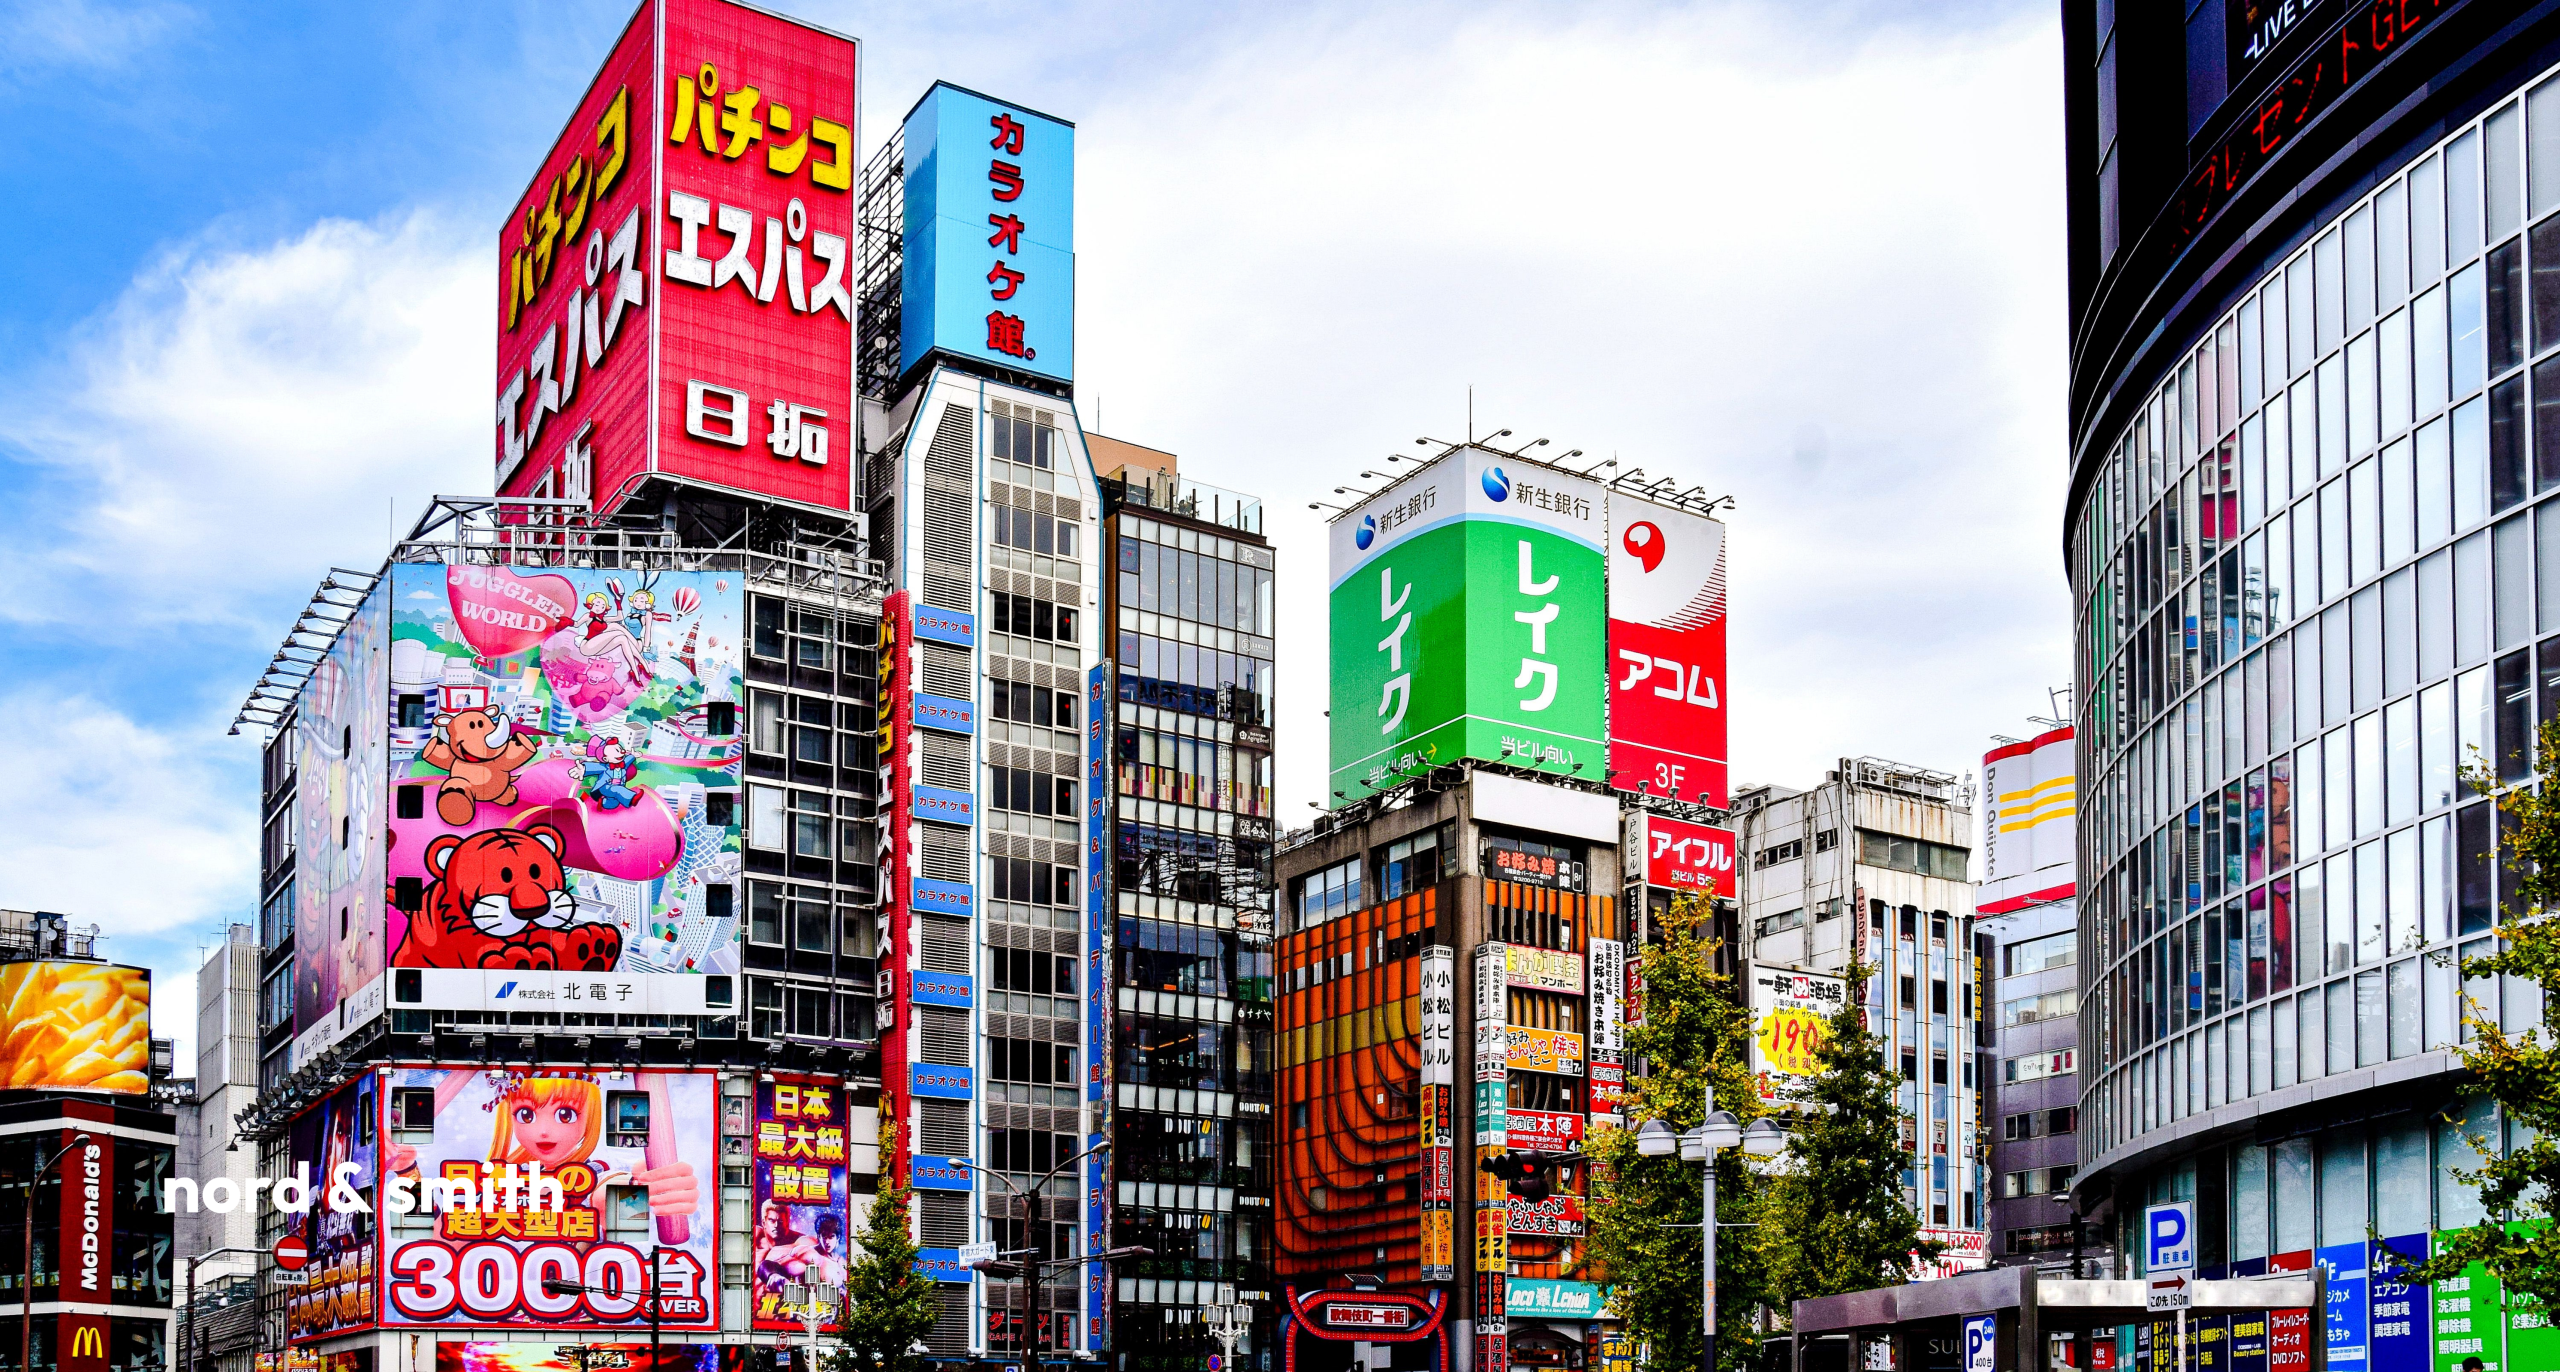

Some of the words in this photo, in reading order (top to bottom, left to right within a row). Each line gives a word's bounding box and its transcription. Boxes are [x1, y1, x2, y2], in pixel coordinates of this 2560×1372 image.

[670, 62, 852, 191] パチンコ
[507, 85, 626, 333] パチンコ
[986, 114, 1025, 358] カラオケ館
[666, 190, 851, 322] エスパス
[496, 204, 643, 492] エスパス
[687, 379, 829, 465] 日拓
[1380, 486, 1437, 535] 新生銀行
[1516, 482, 1590, 521] 新生銀行
[448, 568, 566, 622] JUGGLER
[461, 599, 548, 633] WORLD
[919, 616, 971, 635] カラオケ館
[1514, 540, 1560, 712] レイク
[1378, 566, 1411, 735] レイク
[878, 612, 895, 754] パチンコ
[1619, 648, 1719, 709] アコム
[918, 703, 971, 723] カラオケ館
[1500, 735, 1574, 765] 当ビル向い
[1369, 749, 1423, 784] 当ビル向い
[1655, 762, 1685, 788] 3F
[1987, 767, 1996, 804] Don
[918, 796, 970, 815] カラオケ館
[1628, 819, 1639, 871] 戸谷ビル
[1651, 830, 1732, 871] アイフル
[1987, 809, 1996, 877] Quijote
[877, 764, 894, 956] エスパス
[1497, 850, 1555, 876] お好み焼
[917, 888, 970, 907] カラオケ館
[1506, 948, 1579, 977] まんが喫茶
[518, 989, 555, 1000] 株式会社
[563, 982, 633, 1001] 北電子
[917, 981, 970, 998] カラオケ館
[1540, 977, 1573, 988] マンボー
[1758, 974, 1842, 1003] 一軒め酒場
[876, 968, 893, 1031] 日拓
[1594, 953, 1604, 1046] お好み焼き本陣
[1630, 975, 1639, 1019] アイフル
[1423, 971, 1433, 1066] 小松ビル
[1437, 970, 1450, 1065] 小松ビル
[1507, 1031, 1529, 1046] 好み
[1552, 1034, 1579, 1056] 焼き
[1772, 1017, 1819, 1055] 190
[1507, 1040, 1547, 1060] もんじゃ
[1528, 1050, 1551, 1066] たこ
[1573, 1063, 1581, 1072] 7F
[1592, 1066, 1622, 1083] 居酒屋
[917, 1073, 970, 1090] カラオケ館
[1592, 1083, 1622, 1104] 本陣
[774, 1085, 830, 1119] 日本
[1239, 1101, 1270, 1114] DOUTOR
[1438, 1087, 1448, 1127] お好み焼
[1612, 1105, 1622, 1114] 4F
[1423, 1087, 1433, 1144] 麻雀フル
[758, 1122, 844, 1161] 最大級
[1439, 1136, 1448, 1144] 8F
[1568, 1140, 1582, 1152] 4F
[917, 1165, 970, 1181] カラオケ館
[1439, 1150, 1449, 1188] 居酒屋
[773, 1166, 830, 1200] 設置
[1239, 1195, 1270, 1207] DOUTOR
[1507, 1198, 1565, 1214] ゃぶしゃぶ
[82, 1144, 101, 1290] McDonald's
[447, 1208, 595, 1237] 超大型店
[1571, 1222, 1582, 1233] 4F
[1090, 1148, 1101, 1338] カラオケ館
[1478, 1211, 1488, 1259] 麻雀フル
[1491, 1210, 1503, 1259] 麻雀フル
[2150, 1209, 2186, 1266] P
[1494, 1261, 1502, 1269] 6F
[2162, 1252, 2189, 1264] 駐車場
[2372, 1250, 2393, 1273] 4F
[396, 1249, 699, 1315] 3000台
[1239, 1289, 1270, 1301] DOUTOR
[1479, 1275, 1487, 1315] お好み焼
[1492, 1274, 1503, 1315] お好み焼
[2374, 1284, 2409, 1298] エアコン
[2438, 1277, 2470, 1293] 冷蔵庫
[2151, 1295, 2168, 1307] この先
[2170, 1294, 2189, 1306] 150m
[2326, 1288, 2350, 1304] ジカメ
[2438, 1297, 2471, 1313] 洗濯機
[1331, 1309, 1404, 1324] 歌舞伎町一番街
[2327, 1309, 2343, 1322] ーム
[2374, 1301, 2410, 1318] 季節家電
[988, 1333, 1016, 1342] CAFE
[1038, 1334, 1051, 1342] AR
[1984, 1325, 1994, 1334] 24h
[2233, 1322, 2264, 1337] 理美容家電
[2327, 1328, 2350, 1341] もちゃ
[2374, 1321, 2410, 1337] 調理家電
[2438, 1318, 2471, 1334] 掃除機
[1968, 1328, 1983, 1369] P
[2272, 1333, 2301, 1347] オーディオ
[2438, 1337, 2483, 1355] 照明器具
[1975, 1357, 1992, 1368] 400台
[2200, 1351, 2212, 1365] 日用品
[2233, 1350, 2249, 1358] Beauty
[2272, 1353, 2287, 1365] DVD
[2288, 1351, 2305, 1364] ソフト
